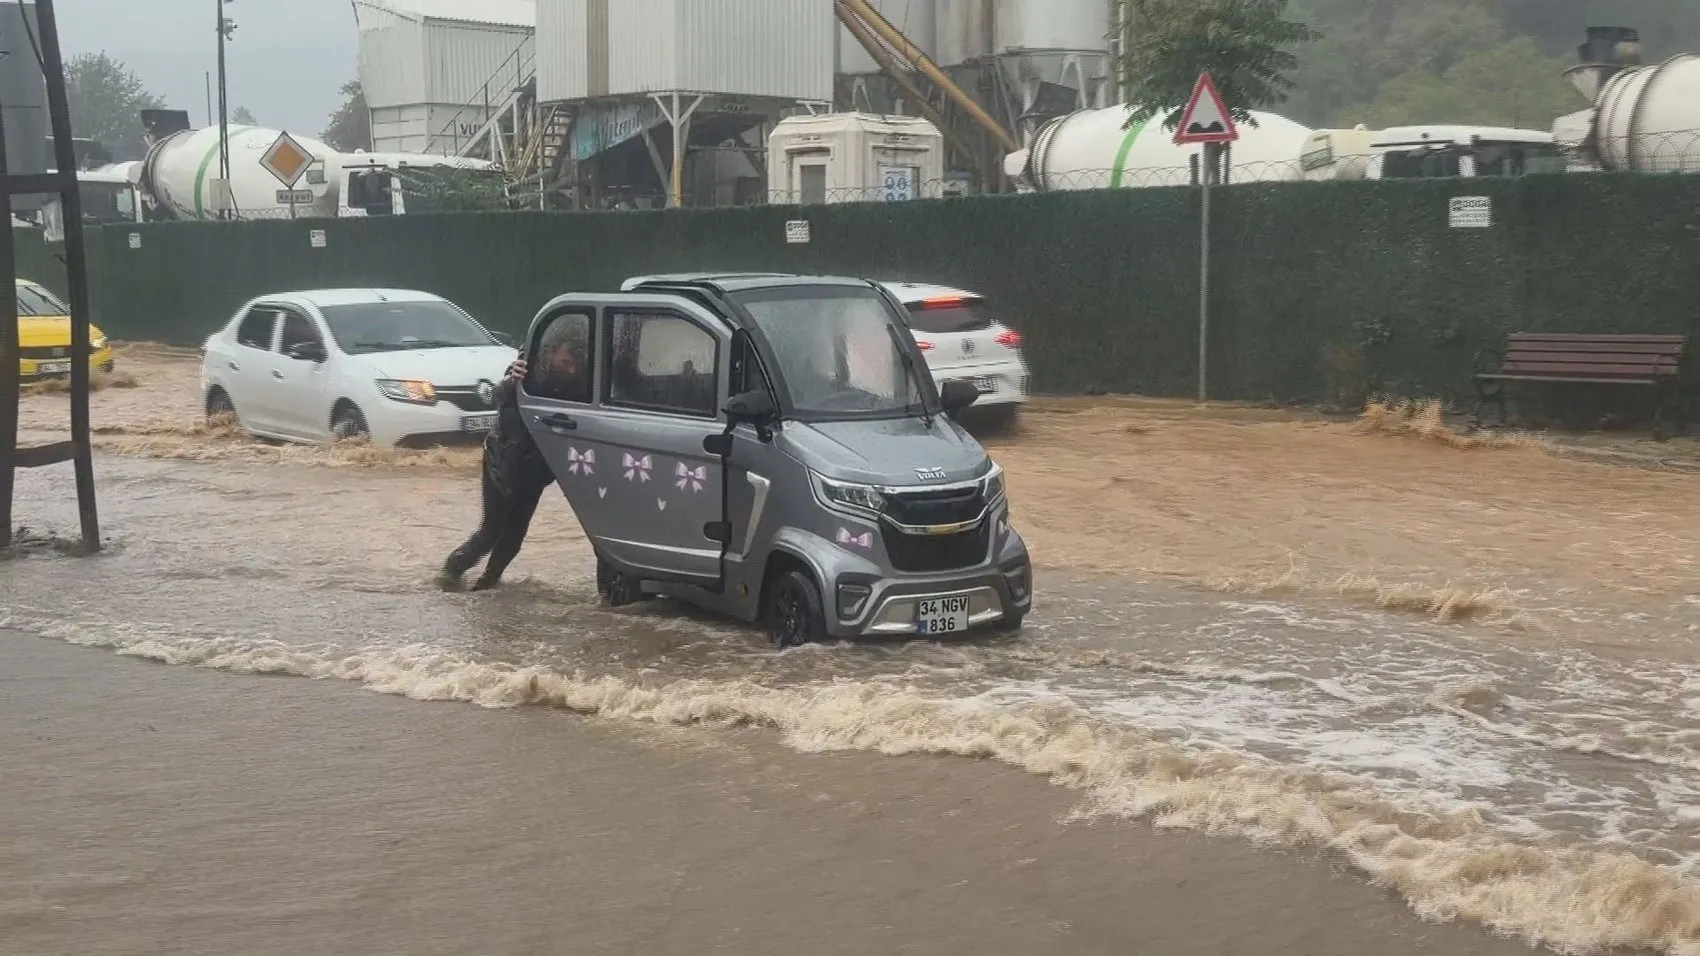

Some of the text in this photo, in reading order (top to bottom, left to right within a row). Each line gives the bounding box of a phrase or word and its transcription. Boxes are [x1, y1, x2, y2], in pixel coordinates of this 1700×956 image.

[916, 471, 948, 482] VOLTA
[921, 597, 967, 616] 34 NGV
[930, 617, 956, 632] 836
